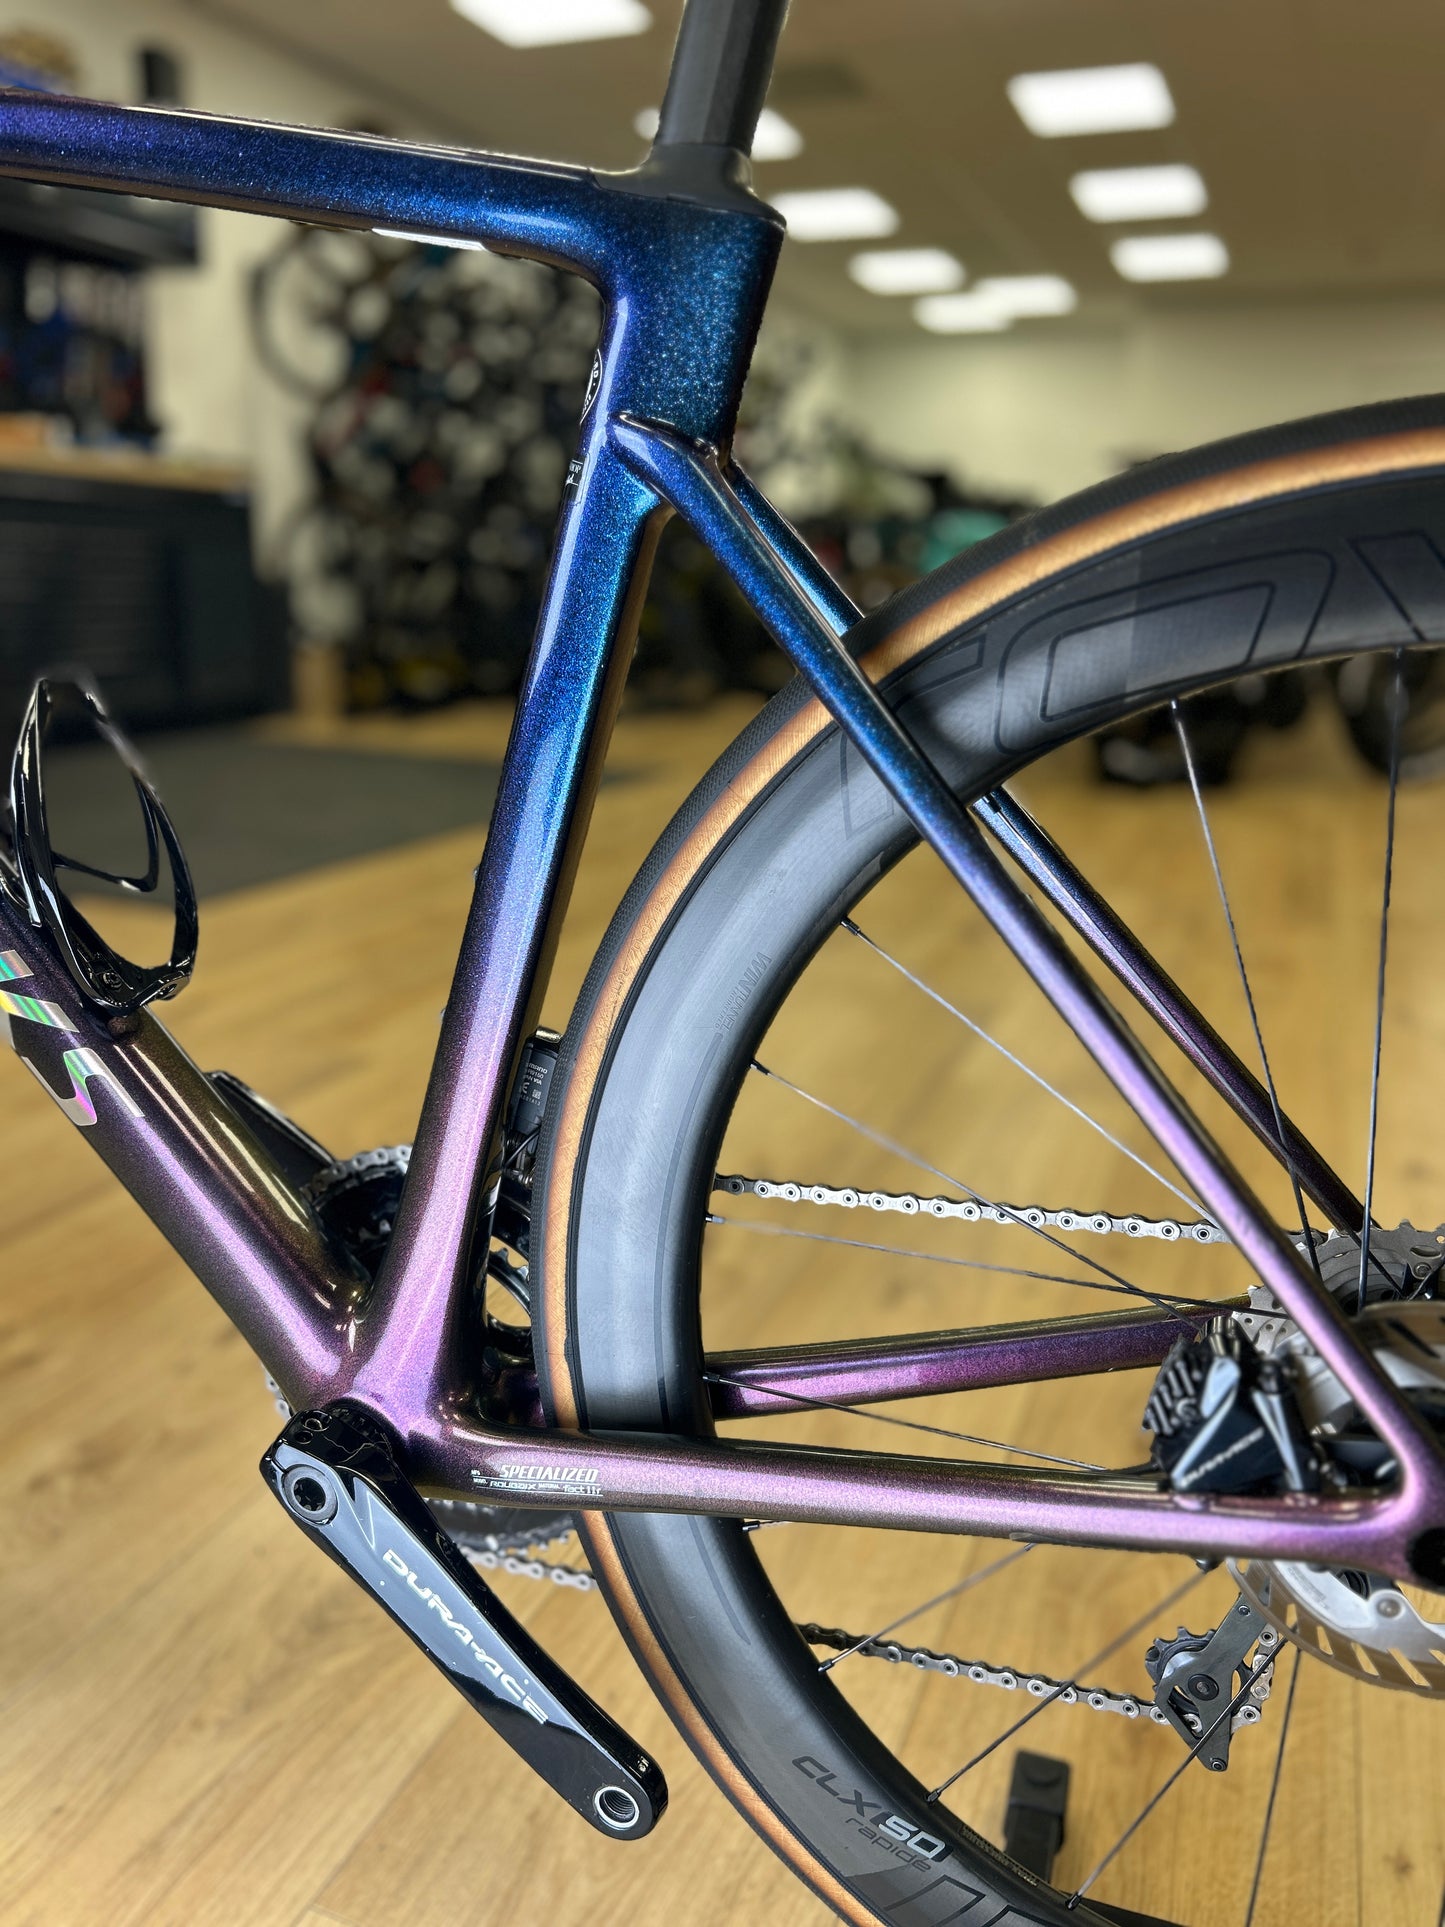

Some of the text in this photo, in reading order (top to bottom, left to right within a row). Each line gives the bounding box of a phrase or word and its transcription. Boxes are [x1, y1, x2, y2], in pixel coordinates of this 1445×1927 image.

[499, 1464, 599, 1483] SPECIALIZED
[382, 1549, 549, 1725] DURA-ACE
[792, 1755, 882, 1818] CLX
[878, 1814, 946, 1860] 50
[844, 1816, 933, 1873] rapide
